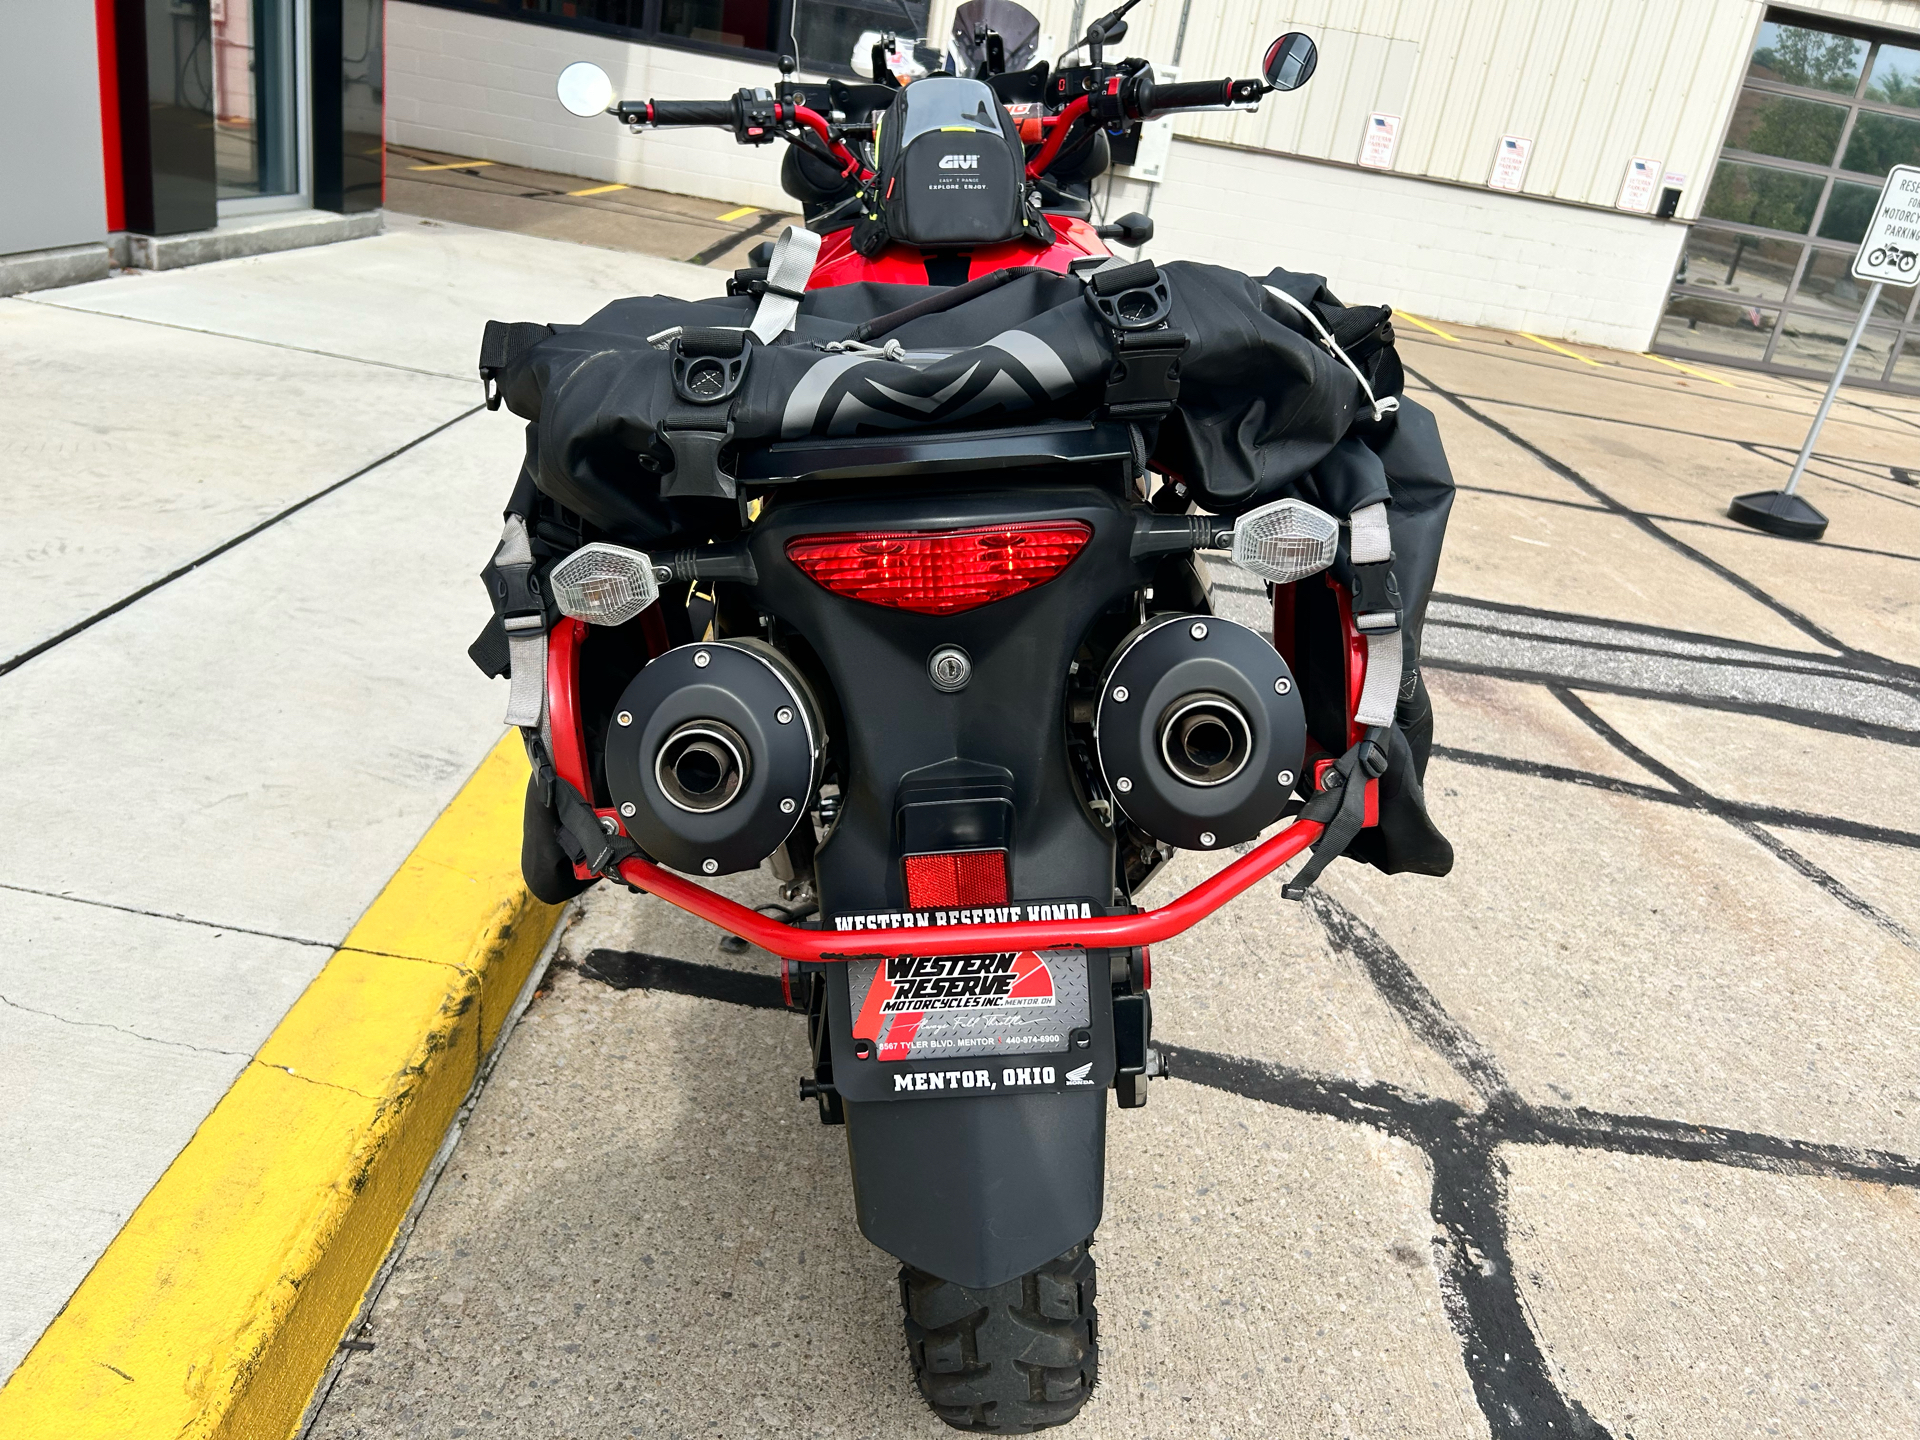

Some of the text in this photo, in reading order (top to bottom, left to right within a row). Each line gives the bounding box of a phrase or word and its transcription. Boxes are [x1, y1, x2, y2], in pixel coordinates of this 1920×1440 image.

[938, 154, 978, 169] GIVI
[835, 902, 1092, 931] WESTERN RESERVE HONDA
[887, 952, 1017, 980] WESTERN
[893, 974, 1017, 1000] RESERVE
[882, 997, 981, 1012] MOTORCYCLES
[981, 996, 1003, 1007] INC.
[1040, 997, 1053, 1005] OH
[893, 1014, 1047, 1035] Always Full Throttle
[879, 1034, 1060, 1051] 8567 TYLER BLVD. MENTOR 440-974-6900
[894, 1069, 997, 1092] MENTOR,
[1002, 1066, 1056, 1086] OHIO
